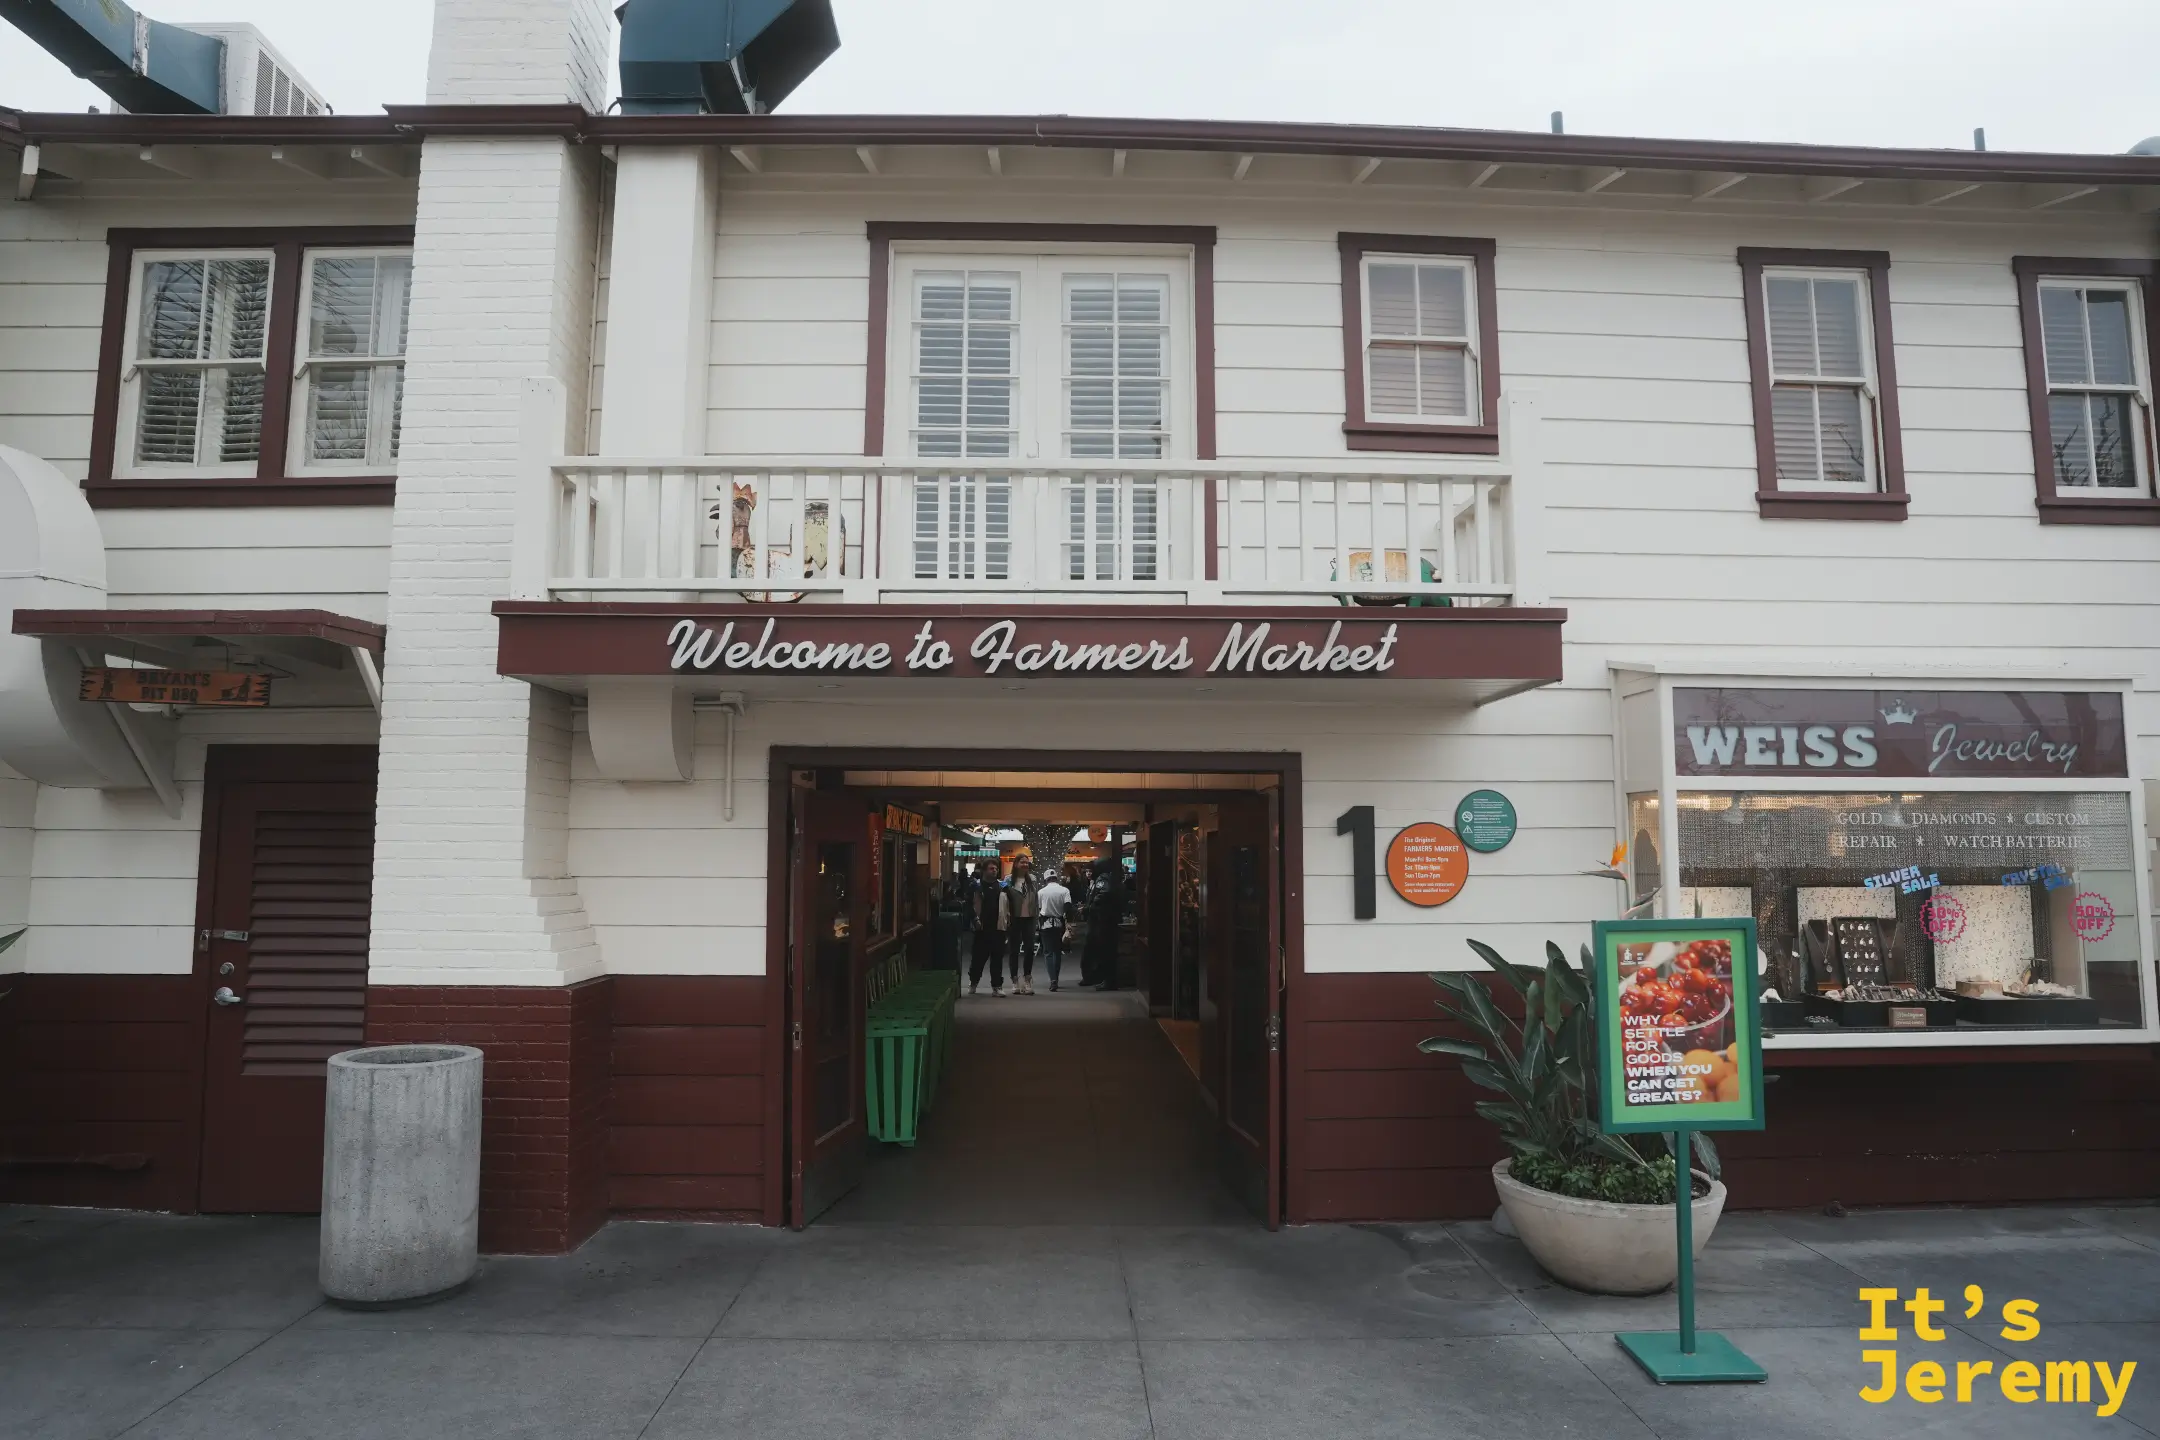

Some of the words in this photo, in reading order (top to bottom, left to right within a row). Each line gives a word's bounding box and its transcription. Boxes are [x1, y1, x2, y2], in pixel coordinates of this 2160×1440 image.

[666, 617, 892, 671] Welcome
[905, 619, 954, 671] to
[970, 619, 1194, 674] Farmers
[1206, 619, 1398, 673] Market
[136, 671, 211, 687] BRYAN'S
[140, 686, 167, 700] PIT
[1686, 725, 1879, 769] WEISS
[1928, 723, 2080, 774] Jewelry
[1837, 812, 1883, 825] GOLD
[1911, 812, 1996, 825] DIAMONDS
[2023, 812, 2090, 825] CUSTOM
[1838, 835, 1898, 848] REPAIR
[1944, 835, 2002, 848] WATCH
[2005, 835, 2092, 848] BATTERIES
[1336, 805, 1376, 919] 1
[1863, 865, 1922, 891] SILVER
[2001, 862, 2067, 888] CRYSTAL
[1901, 873, 1941, 896] SALE
[1927, 905, 1960, 919] 30%
[2075, 904, 2108, 918] 50%
[1928, 918, 1958, 933] OFF
[2076, 917, 2105, 931] OFF
[1624, 1014, 1660, 1026] WHY
[1624, 1026, 1686, 1039] SETTLE
[1625, 1040, 1660, 1053] FOR
[1626, 1052, 1684, 1064] GOODS
[1626, 1065, 1677, 1077] WHEN
[1678, 1063, 1712, 1075] YOU
[1627, 1079, 1661, 1090] CAN
[1664, 1077, 1697, 1089] GET
[1628, 1090, 1702, 1104] GREATS?
